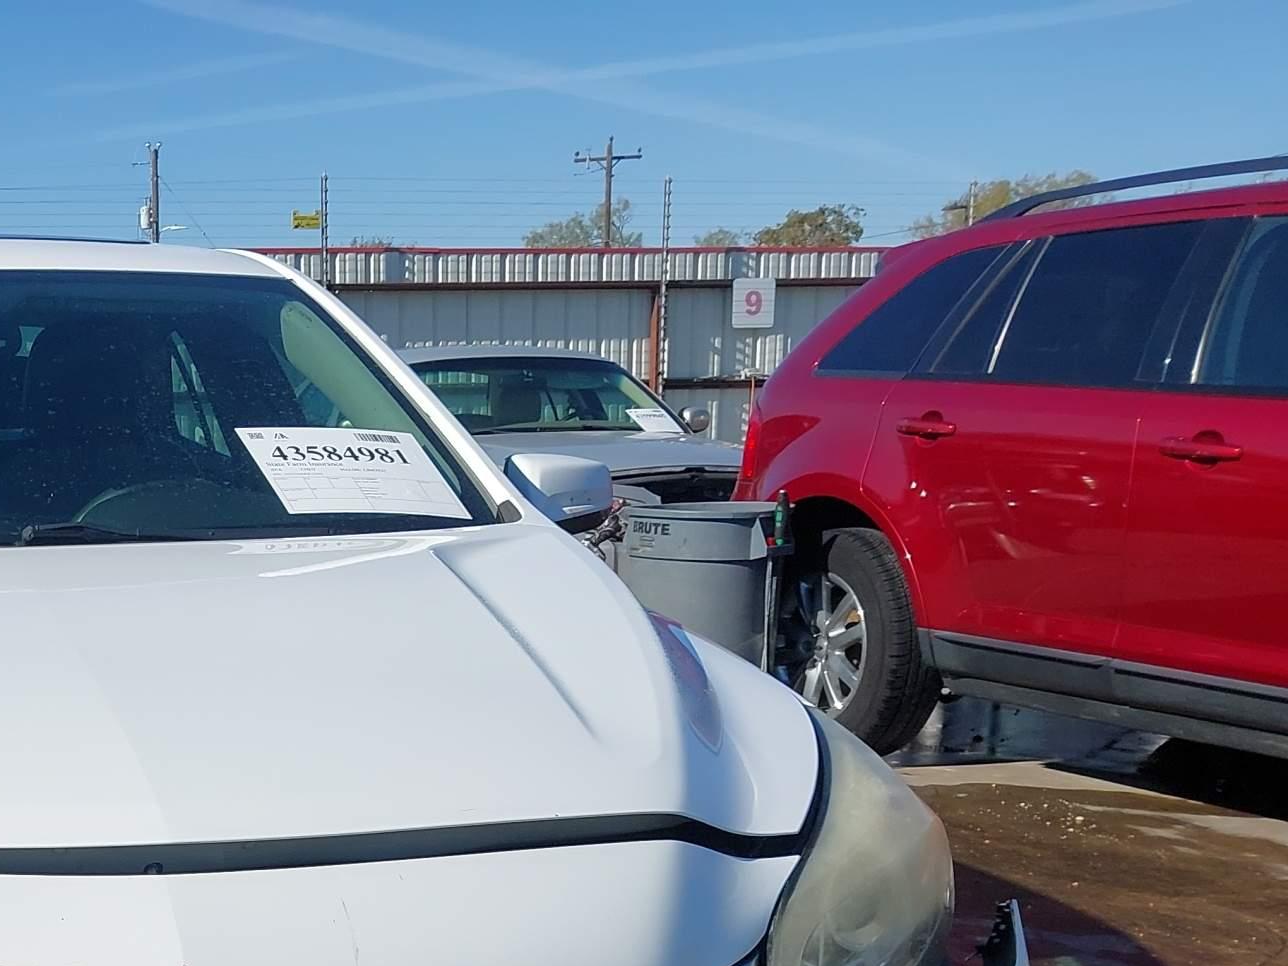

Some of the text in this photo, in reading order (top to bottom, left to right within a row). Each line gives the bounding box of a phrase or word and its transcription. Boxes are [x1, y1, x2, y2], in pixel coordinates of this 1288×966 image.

[745, 290, 763, 316] 9
[271, 445, 410, 465] 43584981
[633, 520, 670, 536] BRUTE
